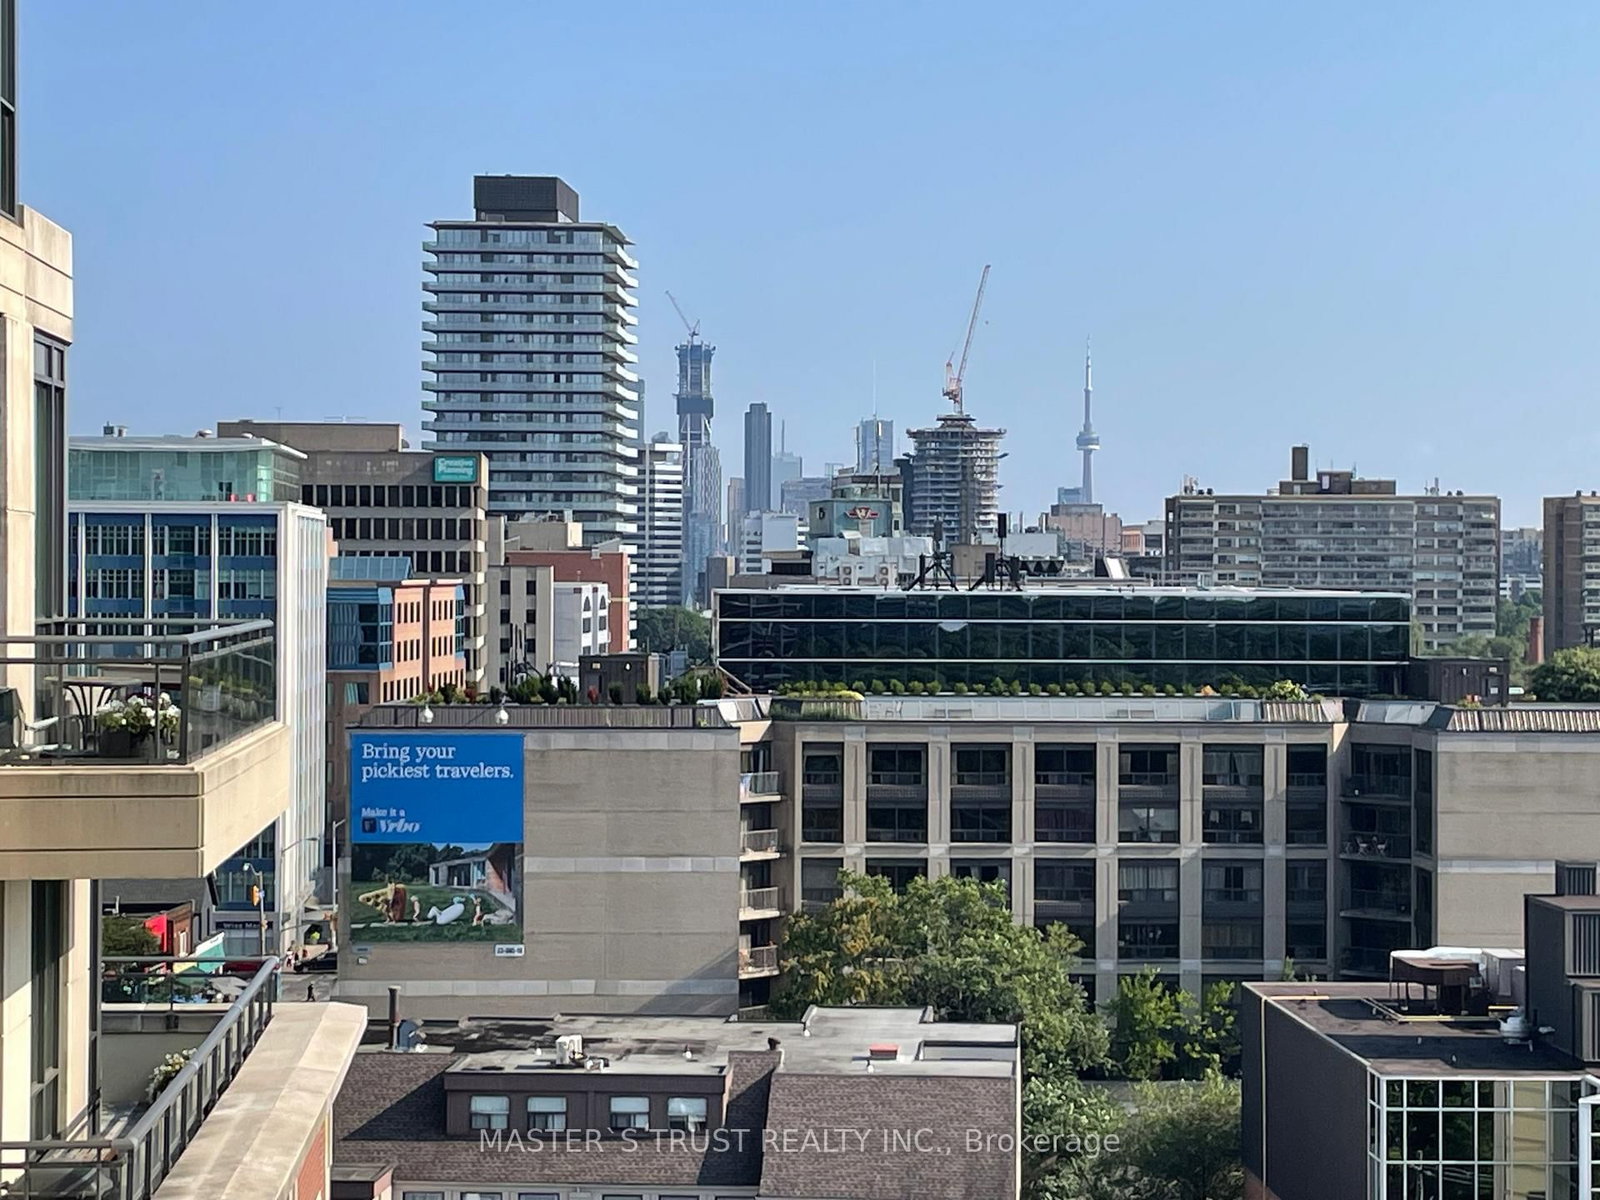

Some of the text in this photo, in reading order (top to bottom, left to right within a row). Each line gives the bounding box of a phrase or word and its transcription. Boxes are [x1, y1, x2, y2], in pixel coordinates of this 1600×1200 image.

[361, 743, 456, 763] Bring your
[361, 762, 514, 783] pickiest travelers.
[361, 807, 406, 817] Make it a
[379, 818, 421, 833] Vrbo
